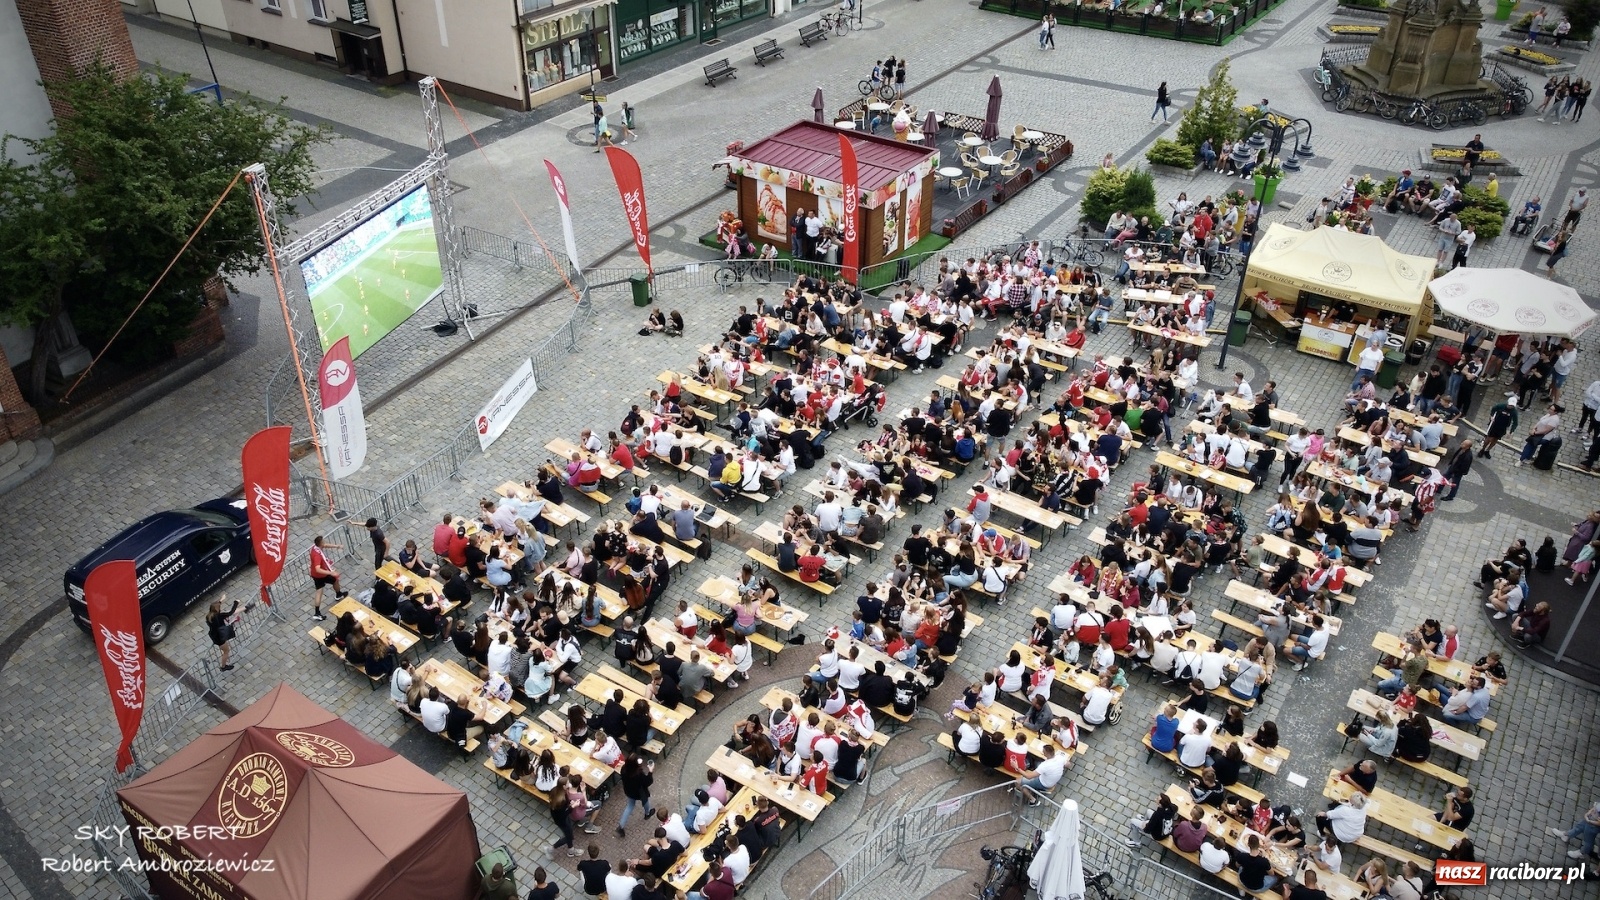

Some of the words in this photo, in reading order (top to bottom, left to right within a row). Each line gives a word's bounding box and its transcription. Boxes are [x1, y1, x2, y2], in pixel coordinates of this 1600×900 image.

[526, 12, 592, 46] STELLA
[487, 370, 533, 423] VANESSA
[337, 405, 352, 467] VANESSA
[252, 796, 276, 821] 1567
